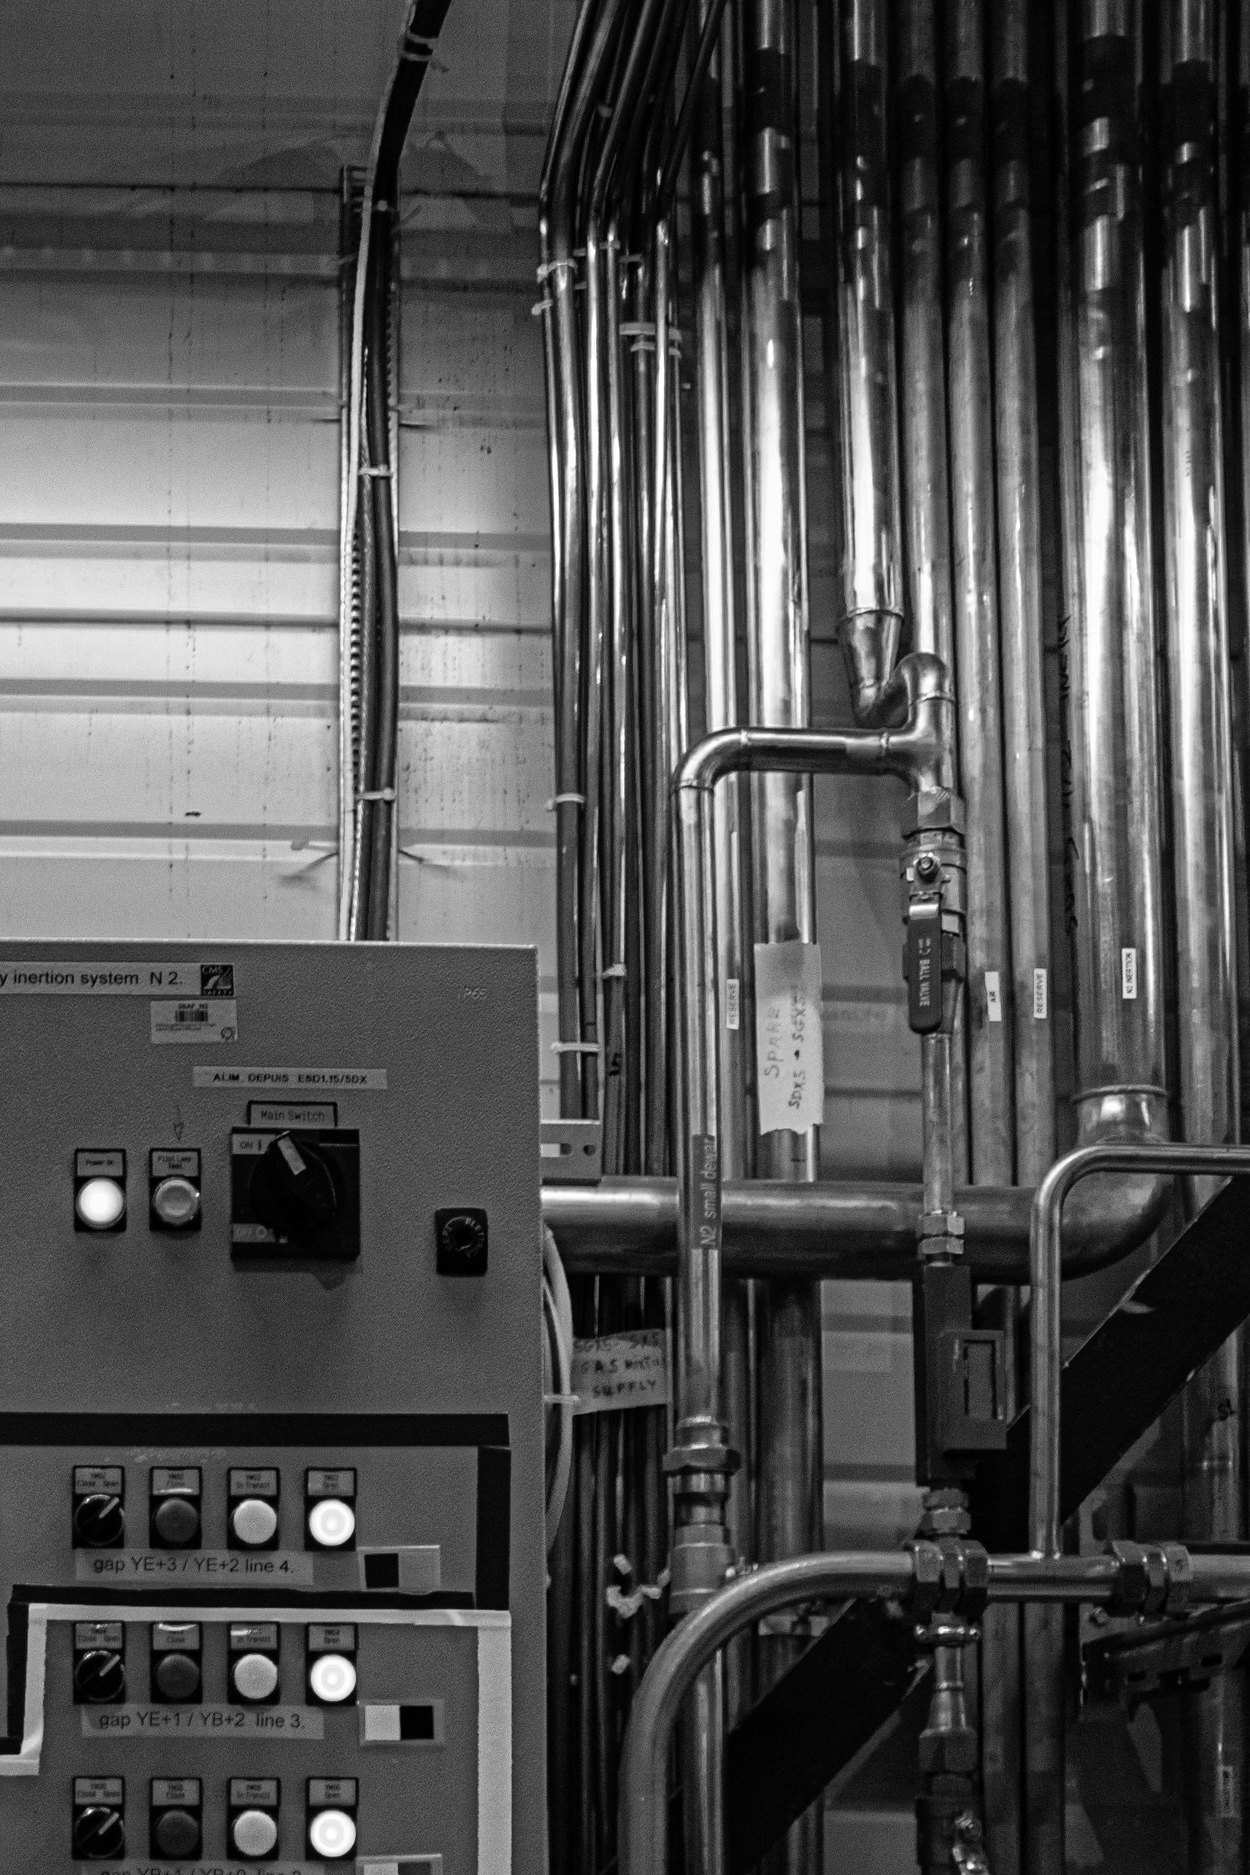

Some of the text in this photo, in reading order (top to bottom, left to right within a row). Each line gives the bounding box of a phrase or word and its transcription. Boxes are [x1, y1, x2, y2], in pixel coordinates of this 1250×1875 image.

[13, 970, 75, 985] inertion
[79, 971, 140, 988] system
[149, 971, 164, 986] N
[248, 1073, 290, 1083] DEPUIS
[260, 1109, 326, 1122] Main Switch
[93, 1559, 126, 1574] gap
[130, 1557, 177, 1571] YE+3
[182, 1558, 189, 1571] /
[194, 1557, 239, 1572] YE+2
[245, 1558, 274, 1572] line
[99, 1714, 131, 1729] gap
[136, 1711, 181, 1727] YE+1
[187, 1711, 194, 1727] /
[200, 1712, 245, 1728] YB+2
[256, 1713, 285, 1728] line
